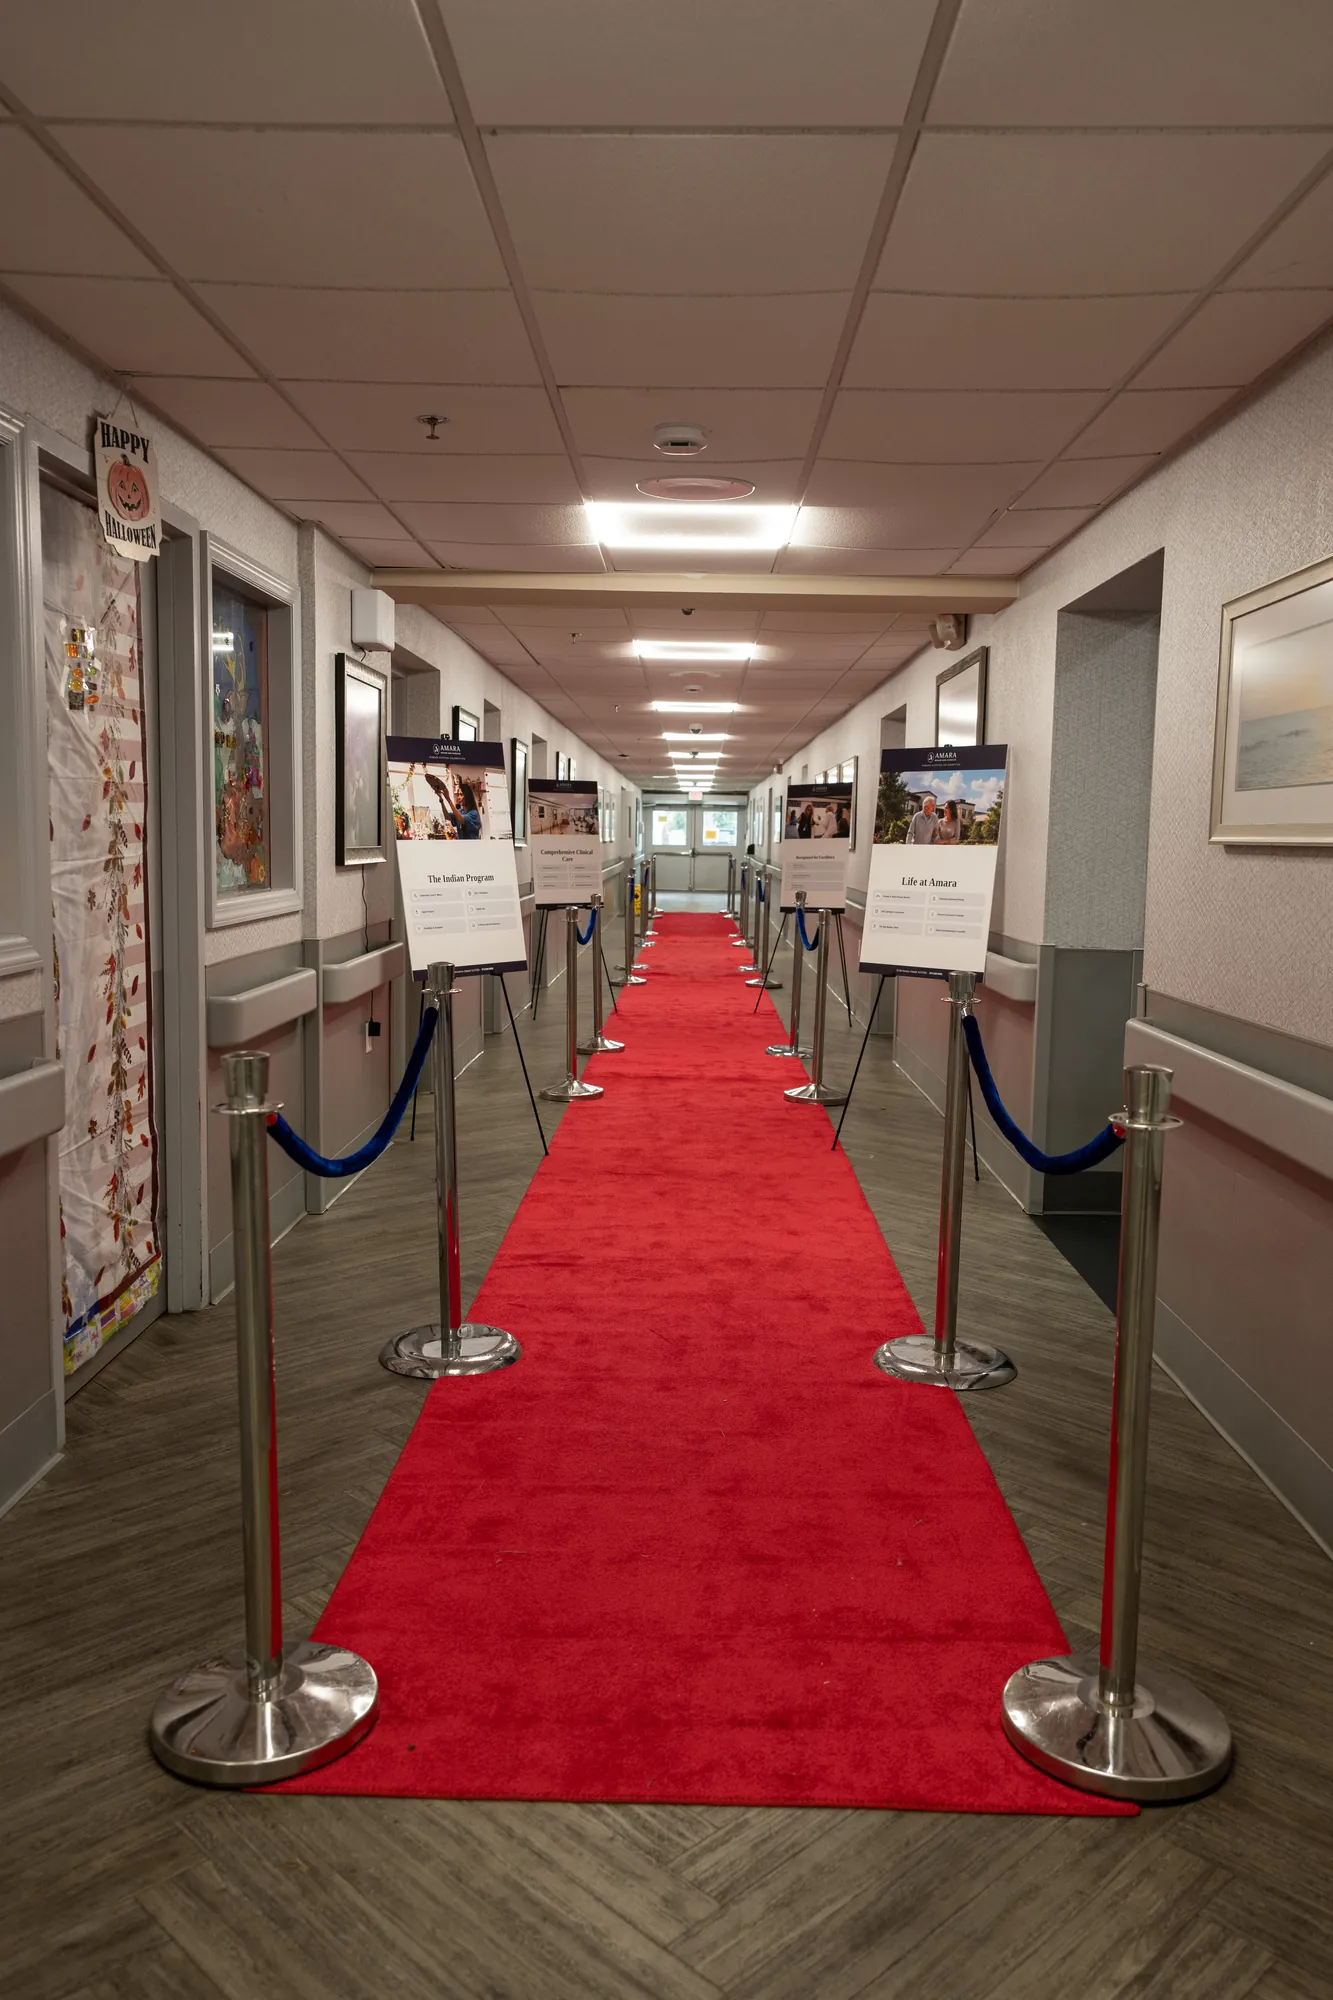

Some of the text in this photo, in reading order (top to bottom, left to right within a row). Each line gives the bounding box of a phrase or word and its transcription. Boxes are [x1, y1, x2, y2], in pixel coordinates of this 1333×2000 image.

[101, 422, 149, 463] HAPPY
[105, 510, 157, 549] HALLOWEEN
[428, 874, 495, 883] The Indian Program
[901, 876, 957, 888] Life at Amara
